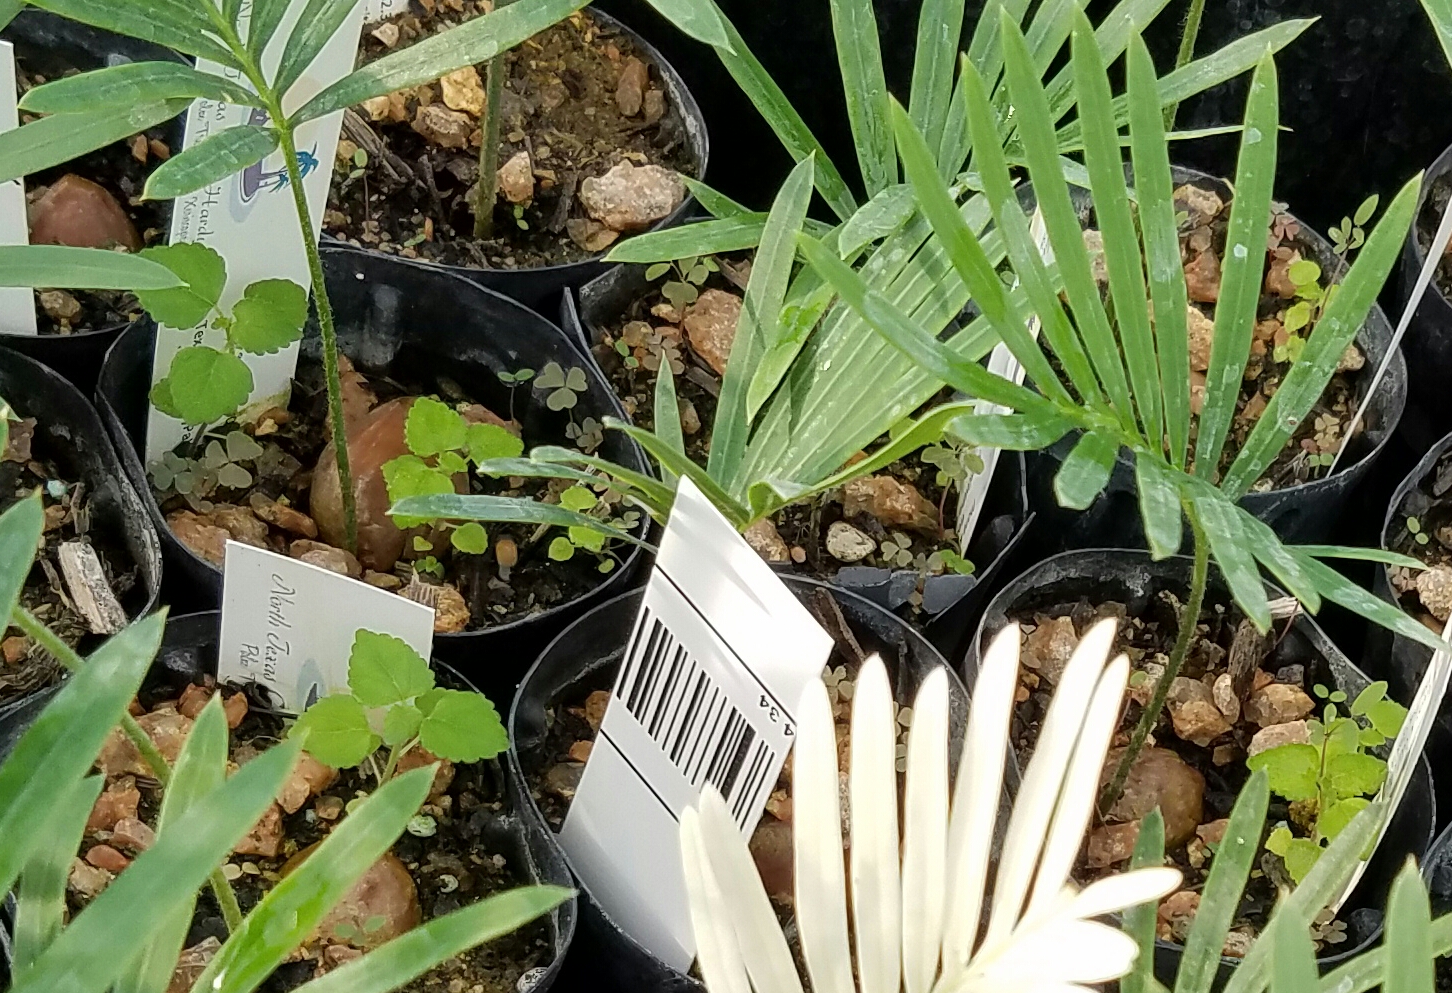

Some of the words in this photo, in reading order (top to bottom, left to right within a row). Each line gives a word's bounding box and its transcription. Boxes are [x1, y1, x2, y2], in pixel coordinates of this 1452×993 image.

[268, 573, 297, 629] North
[263, 632, 291, 683] Texas
[760, 694, 780, 723] 34
[784, 723, 795, 736] 4
